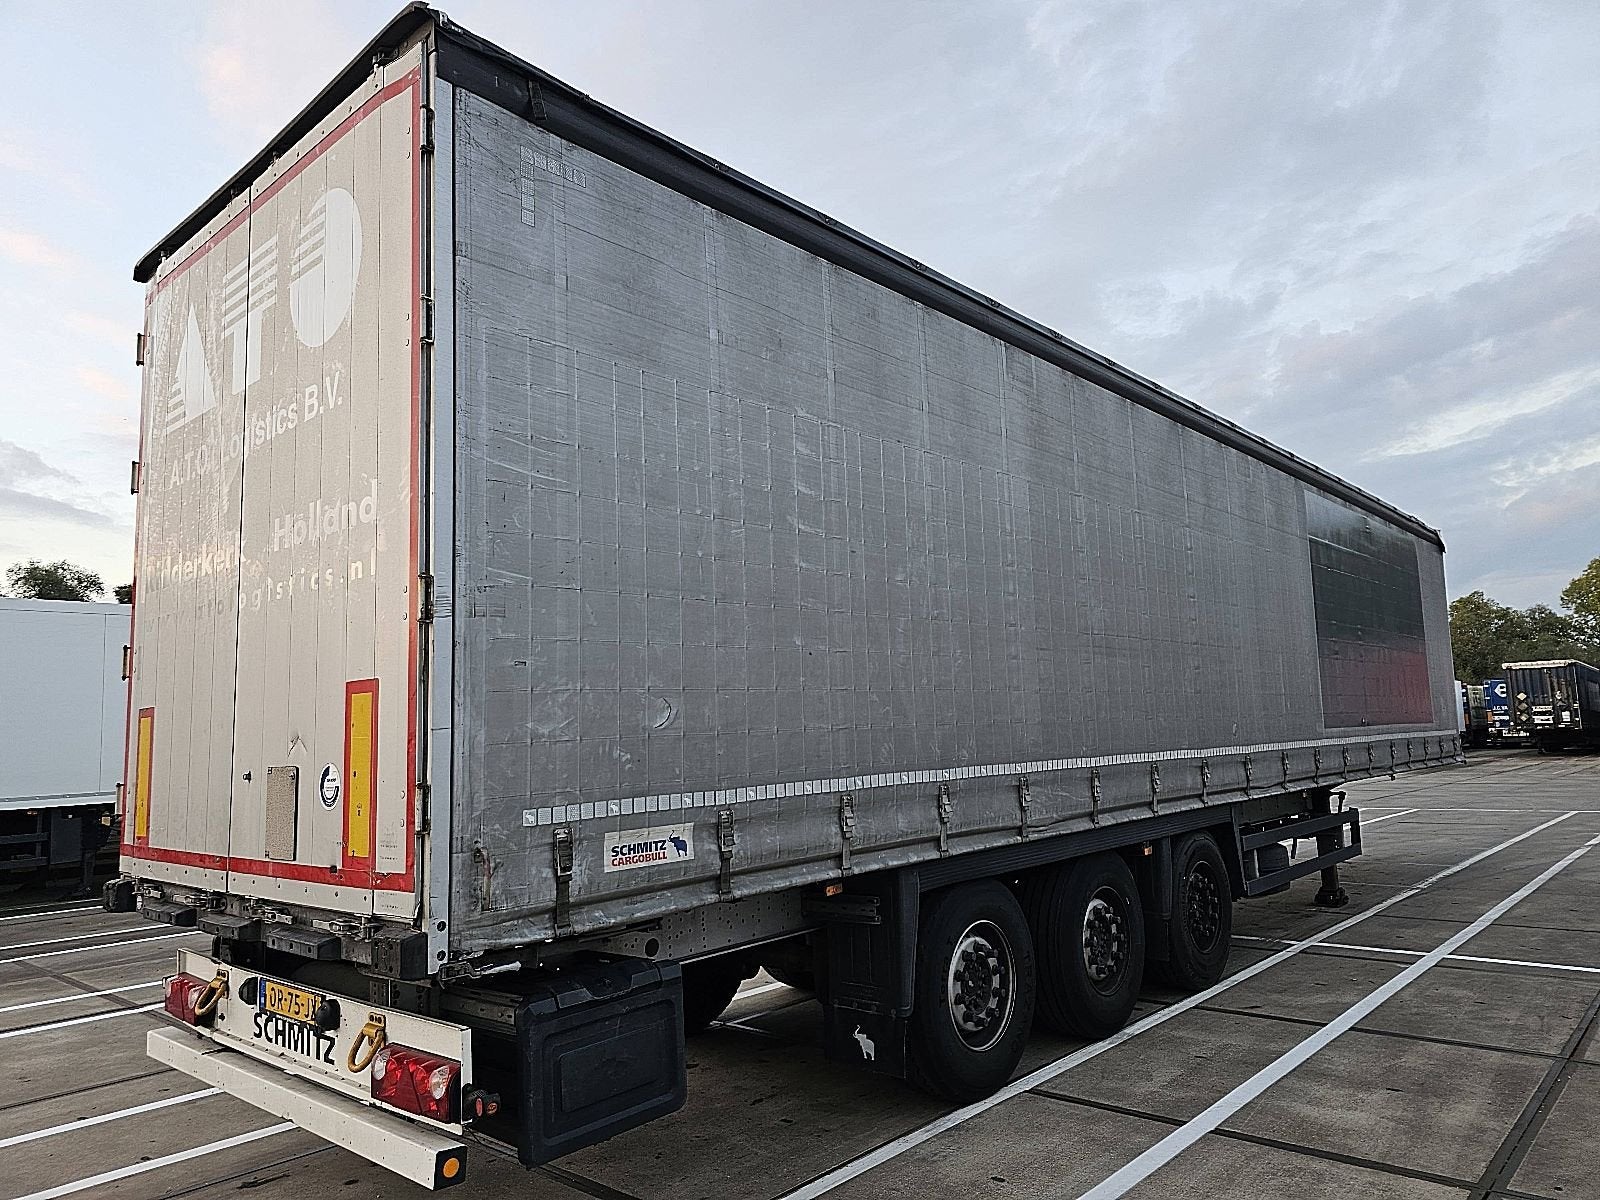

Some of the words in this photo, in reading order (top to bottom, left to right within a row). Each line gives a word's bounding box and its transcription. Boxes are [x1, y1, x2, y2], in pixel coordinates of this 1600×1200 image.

[165, 187, 363, 436] ATO
[304, 370, 344, 422] B.V.
[273, 478, 378, 552] Holland
[611, 840, 667, 858] SCHMITZ
[611, 851, 668, 867] CARGOBULL
[253, 1012, 336, 1065] SCHMITZ
